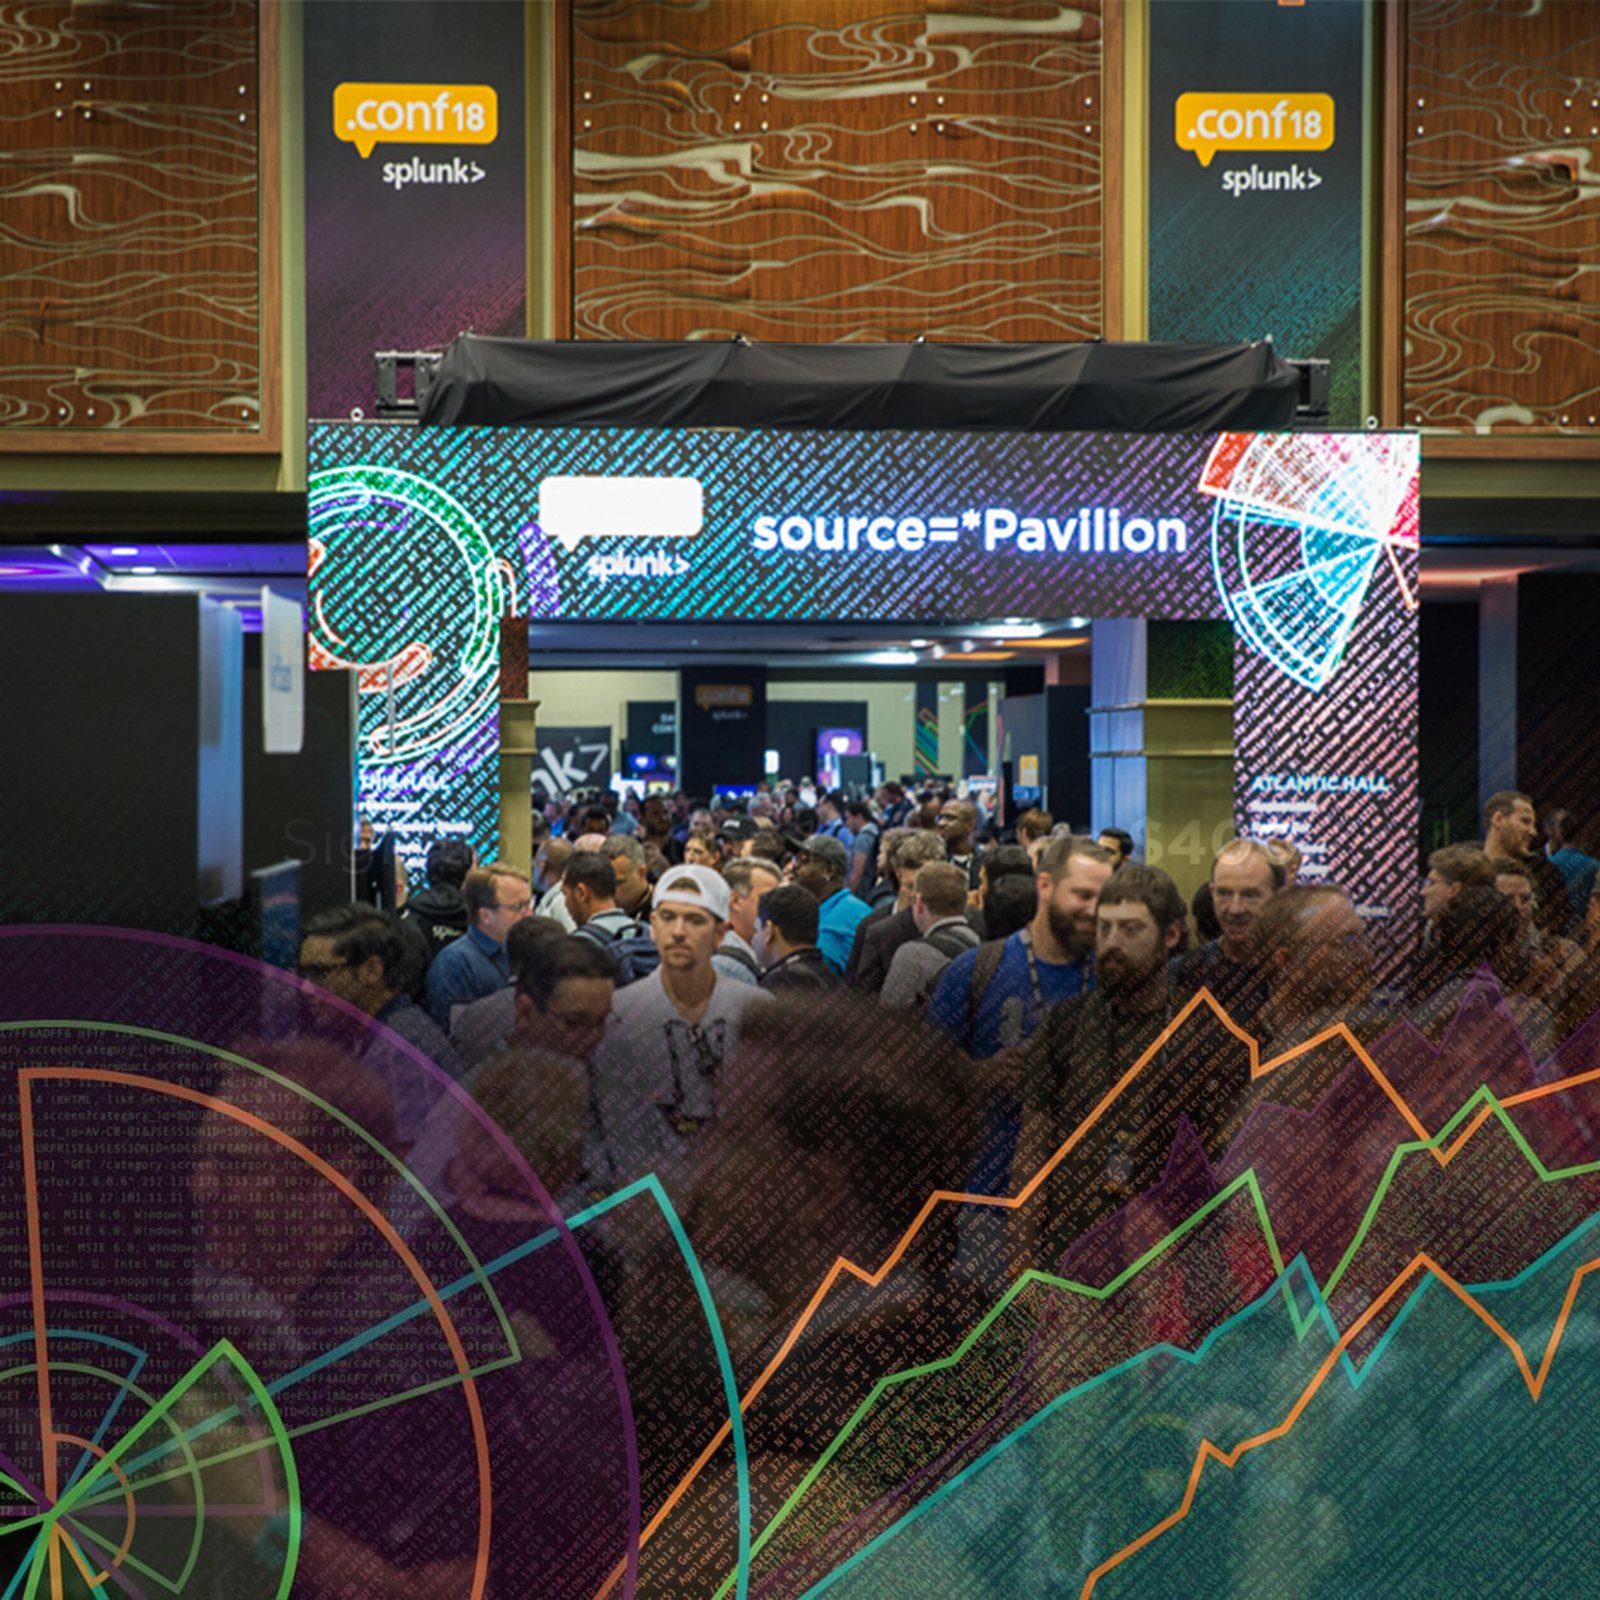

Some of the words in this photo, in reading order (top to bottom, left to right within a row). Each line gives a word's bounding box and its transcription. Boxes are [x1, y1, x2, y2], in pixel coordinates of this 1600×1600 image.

[346, 91, 486, 132] .conf18
[1187, 100, 1322, 139] .conf18
[382, 156, 486, 190] splunk>
[1221, 164, 1322, 197] splunk>
